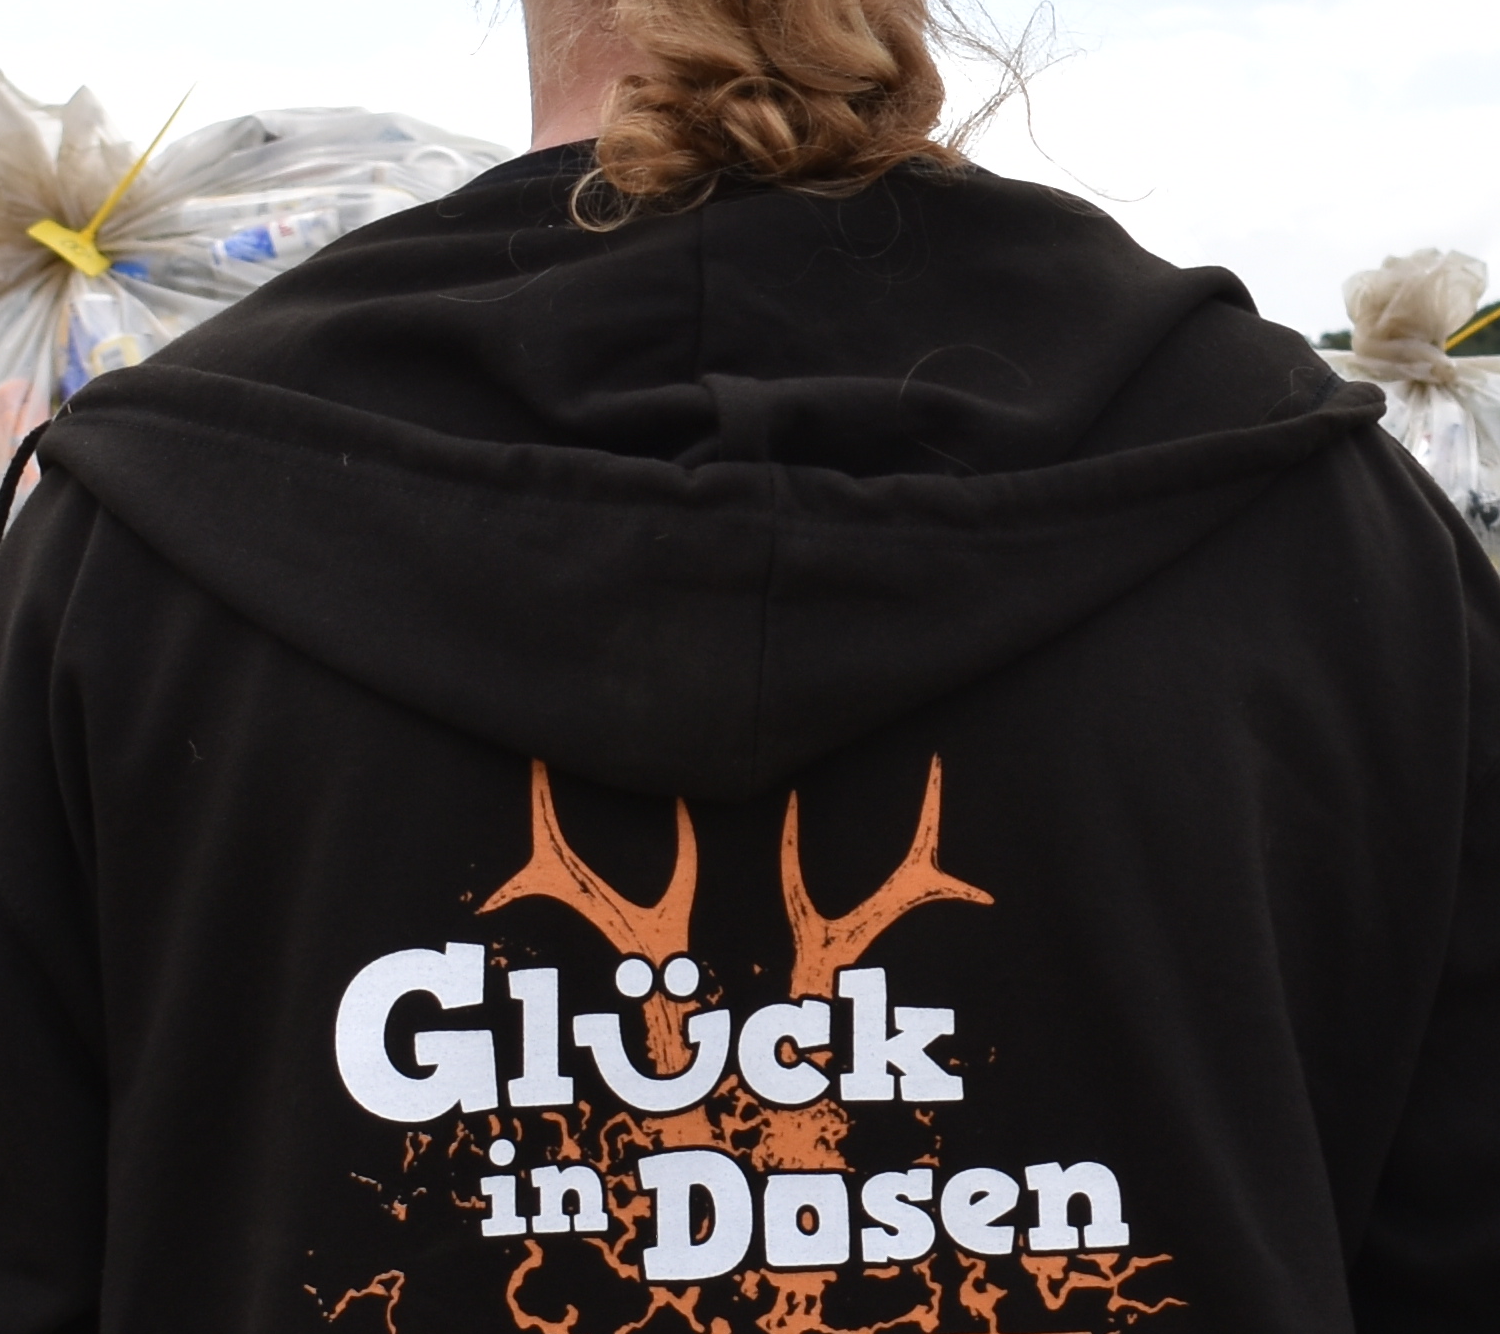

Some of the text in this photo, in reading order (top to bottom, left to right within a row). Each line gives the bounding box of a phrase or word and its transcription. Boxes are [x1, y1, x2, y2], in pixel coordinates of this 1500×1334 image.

[335, 942, 963, 1122] Glück
[481, 1139, 1129, 1280] in Dosen
